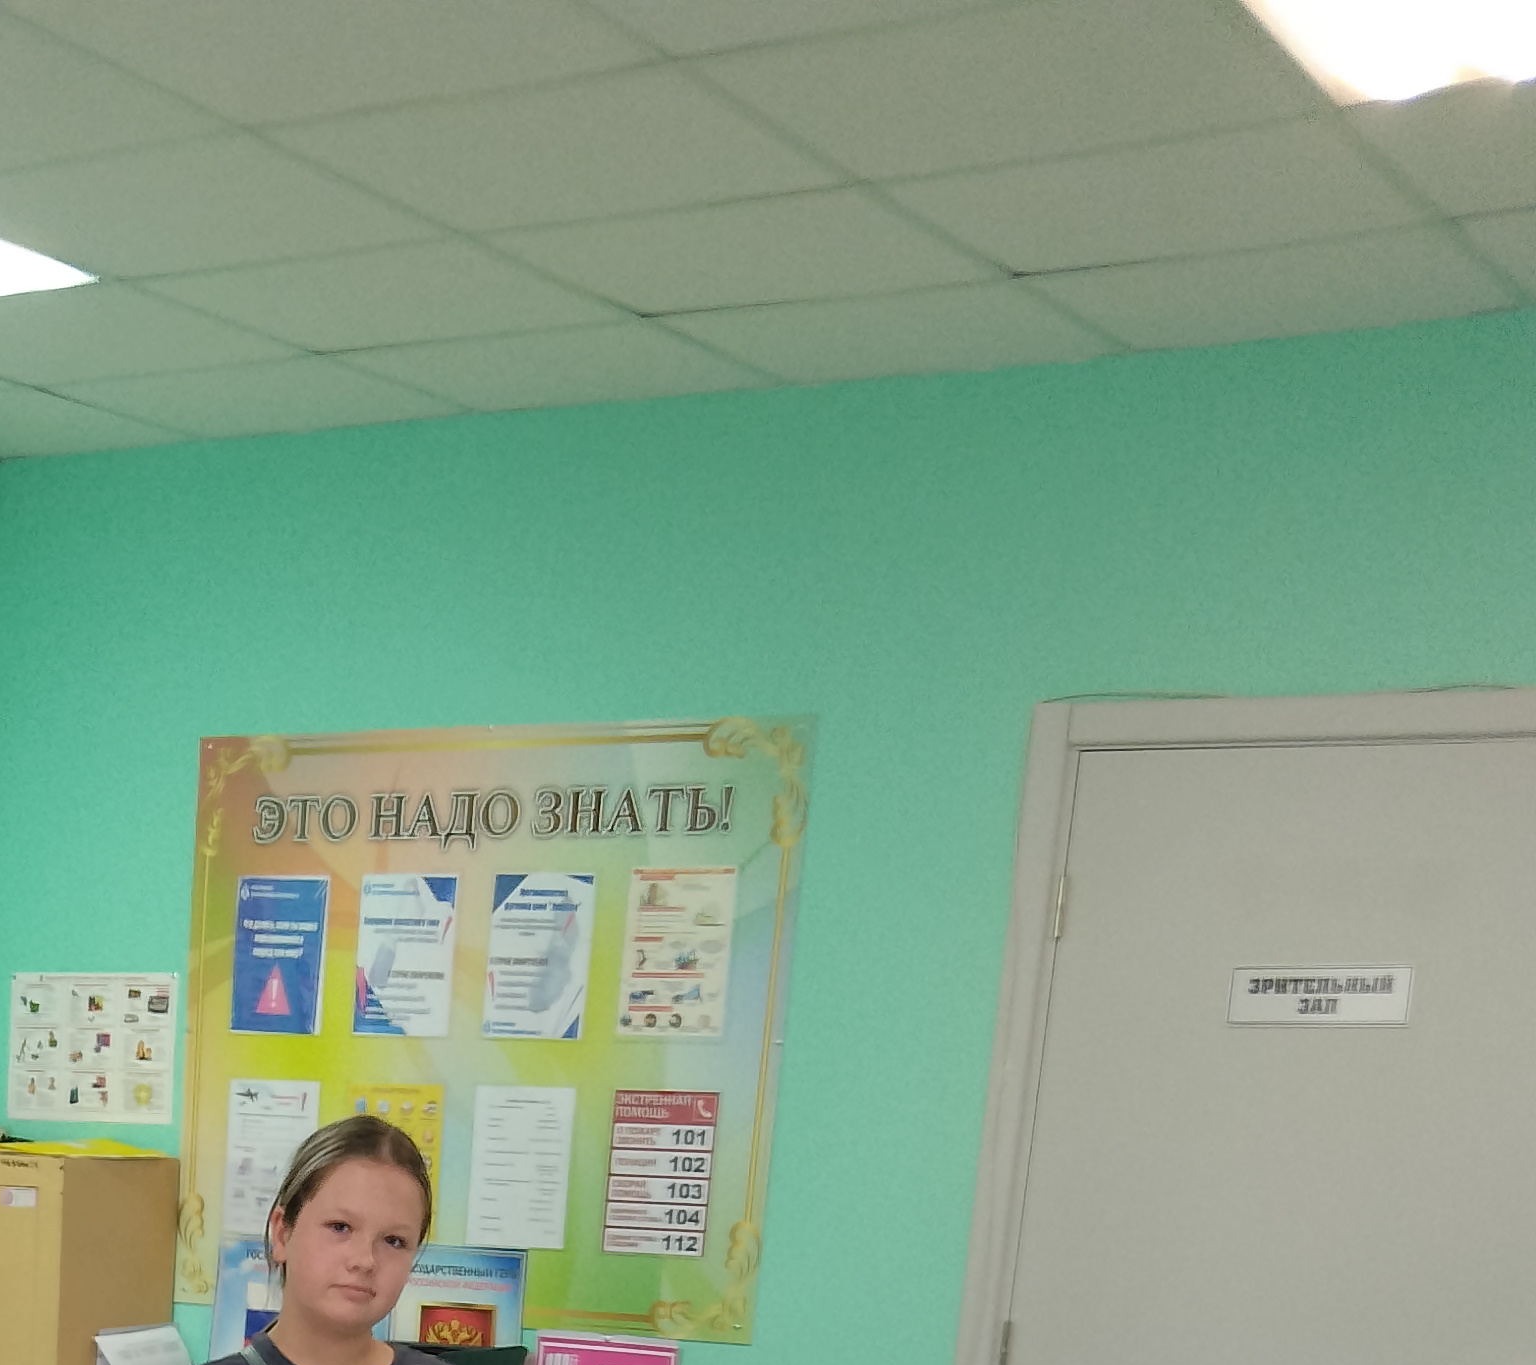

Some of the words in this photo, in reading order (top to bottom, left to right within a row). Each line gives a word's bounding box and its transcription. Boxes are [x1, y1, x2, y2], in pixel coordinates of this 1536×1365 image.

[252, 794, 358, 845] ЭТО
[368, 788, 521, 850] НАДО
[531, 783, 737, 839] ЗНАТЬ!
[1248, 975, 1394, 995] ЗРИТЕЛЬНЫЙ
[1297, 998, 1340, 1014] ЗАЛ
[614, 1105, 669, 1119] ПОМОЩЬ
[672, 1129, 707, 1146] 101
[669, 1156, 706, 1173] 102
[667, 1182, 703, 1200] 103
[665, 1209, 700, 1226] 104
[662, 1235, 698, 1252] 112
